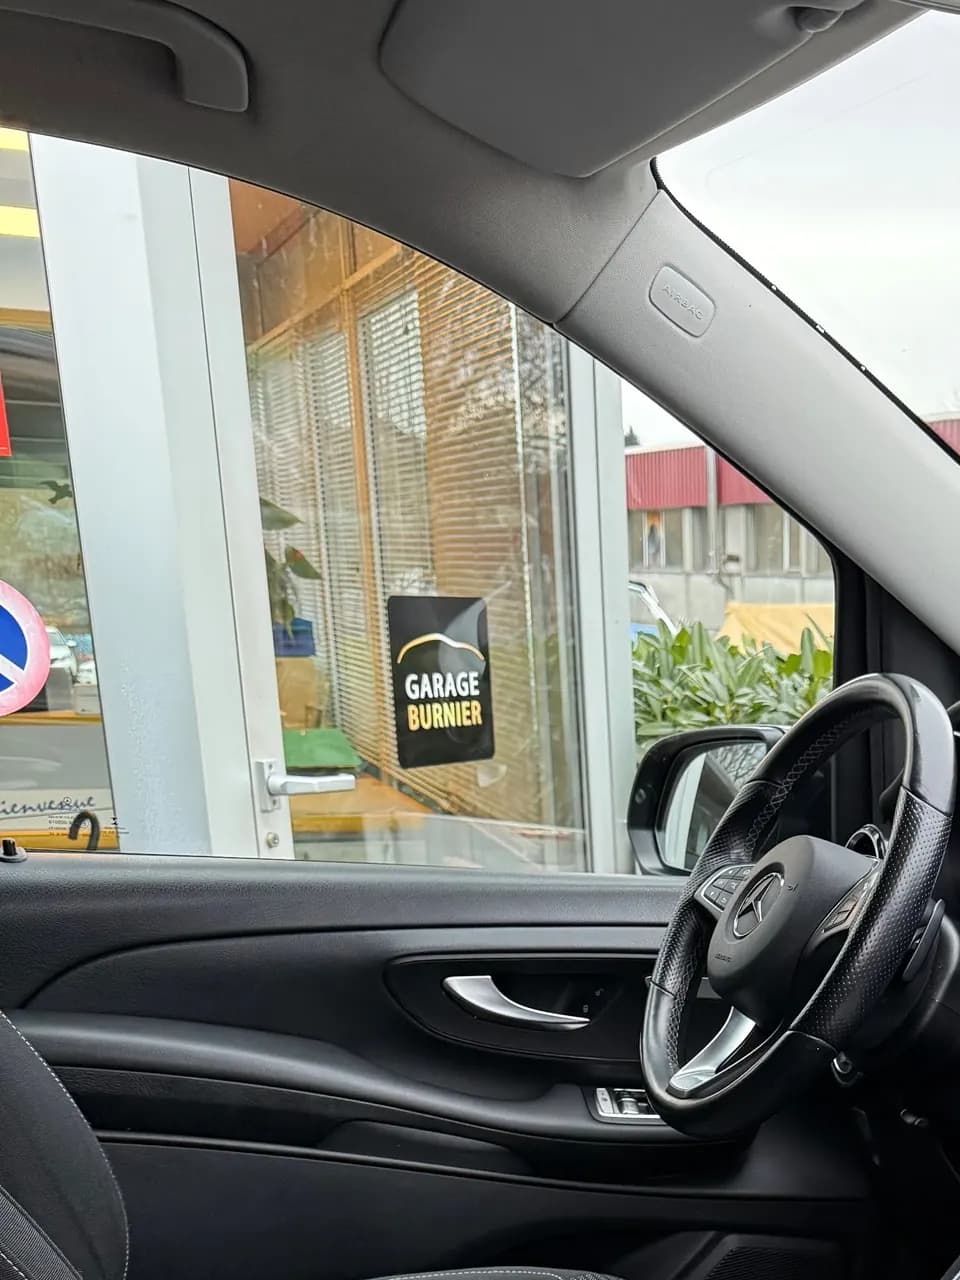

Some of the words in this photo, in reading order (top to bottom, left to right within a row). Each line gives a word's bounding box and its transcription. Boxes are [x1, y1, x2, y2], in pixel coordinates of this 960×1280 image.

[405, 671, 480, 700] GARAGE
[407, 700, 482, 731] BURNIER
[0, 796, 96, 815] ienvenue
